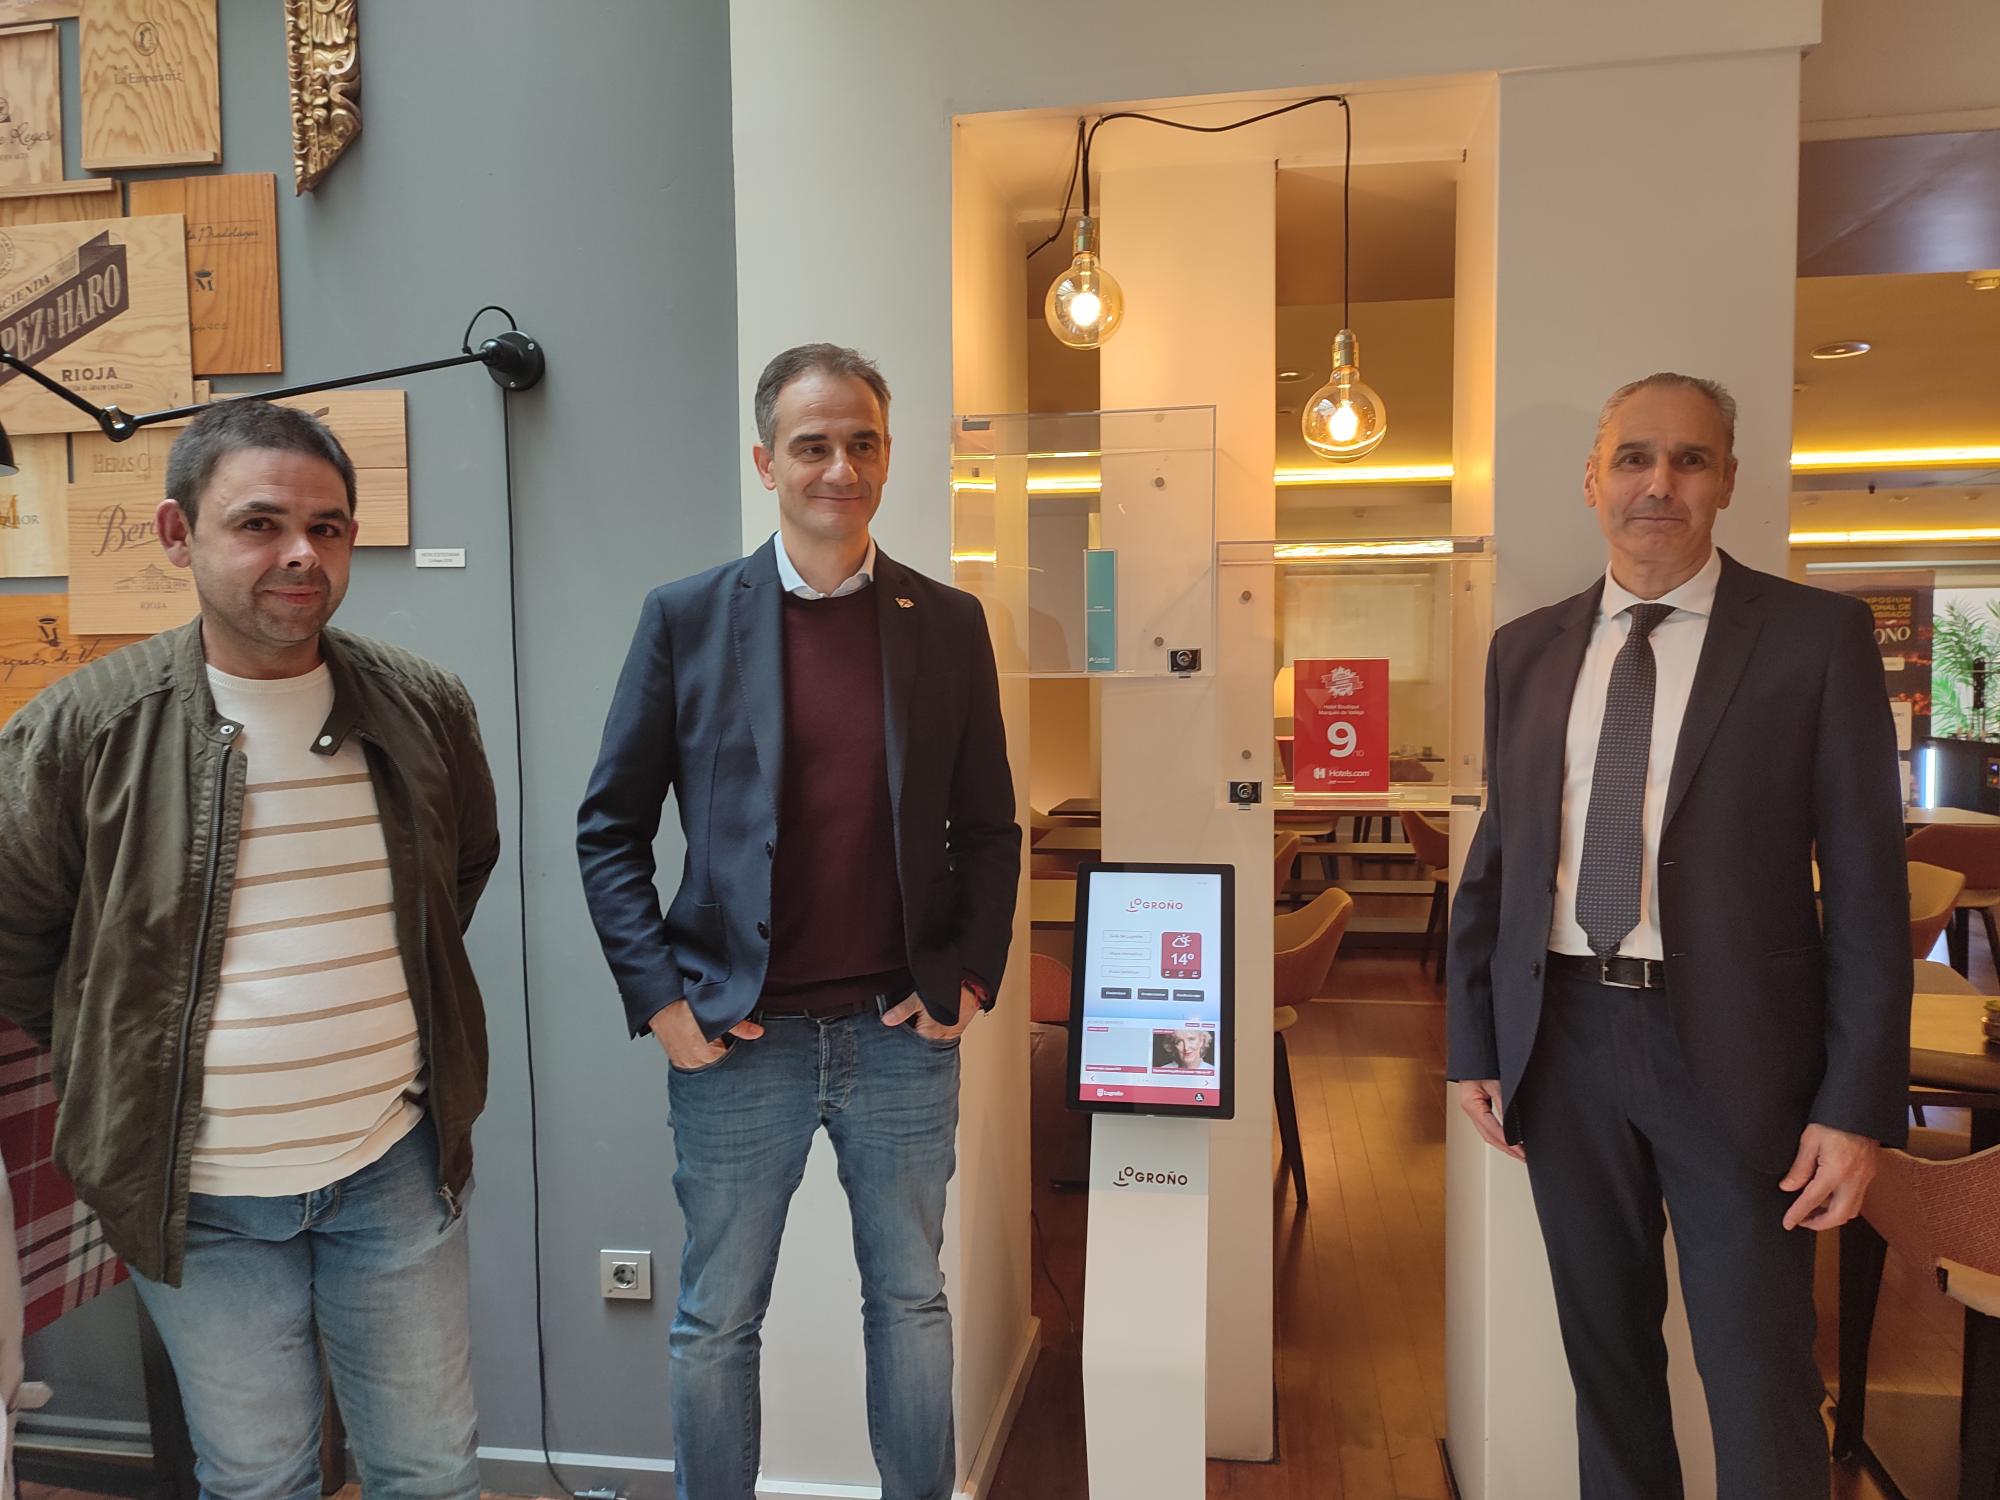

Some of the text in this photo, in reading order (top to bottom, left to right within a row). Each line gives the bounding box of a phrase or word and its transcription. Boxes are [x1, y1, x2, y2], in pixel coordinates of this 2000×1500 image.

[0, 273, 51, 316] CIENDA
[0, 307, 47, 372] PEZ
[55, 263, 121, 340] HARO
[61, 366, 119, 383] RIOJA
[92, 453, 134, 473] HERAS
[1327, 721, 1357, 758] 9
[1328, 769, 1370, 777] Hotels.com
[1128, 898, 1184, 911] LOGROÑO
[1117, 1166, 1189, 1186] LOGROÑO
